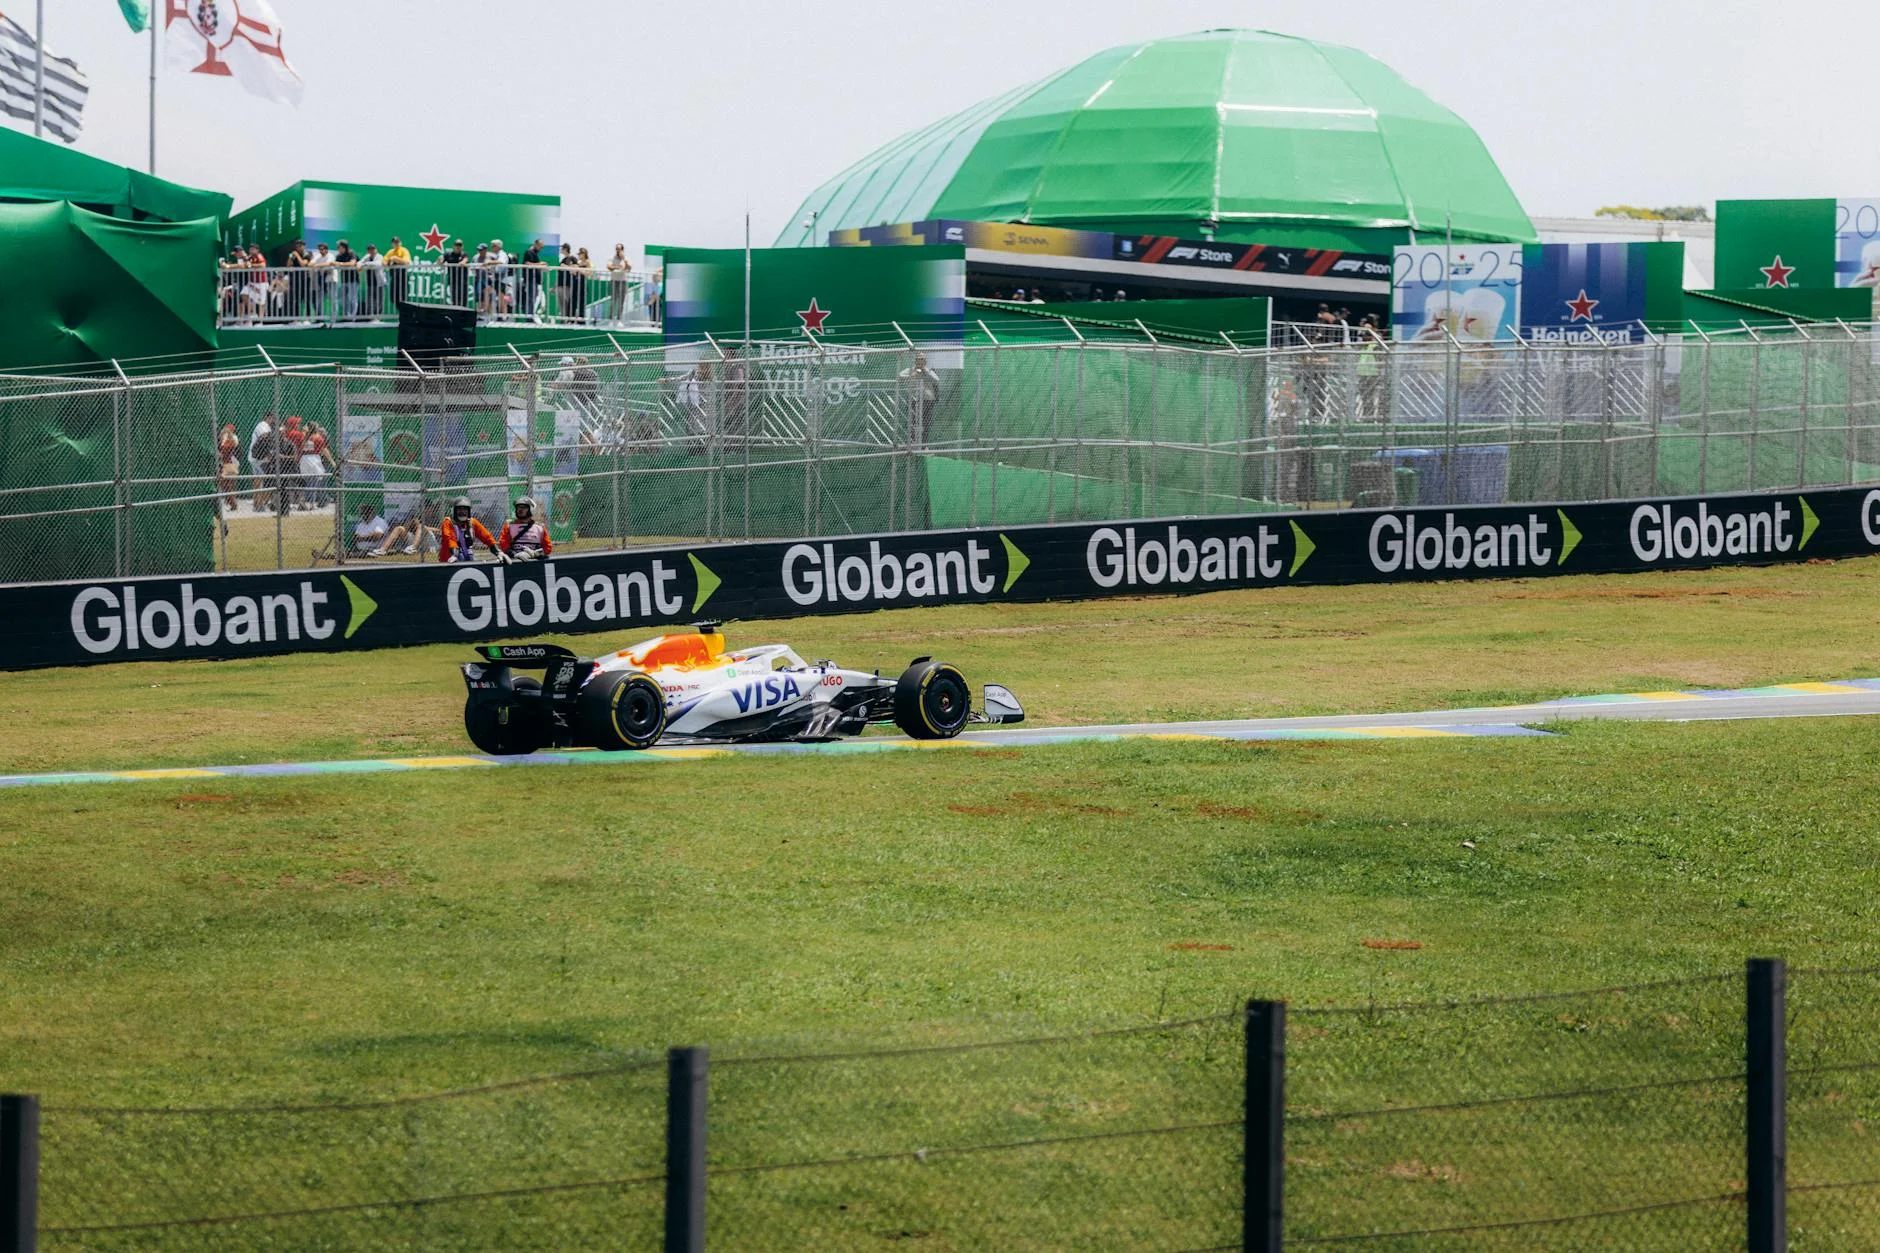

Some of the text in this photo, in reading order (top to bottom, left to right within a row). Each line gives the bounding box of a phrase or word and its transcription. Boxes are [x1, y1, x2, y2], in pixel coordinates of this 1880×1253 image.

[1200, 248, 1233, 262] Store
[1364, 261, 1392, 274] Stor
[1531, 325, 1631, 346] Heineken
[1369, 514, 1552, 572] Globant
[1629, 502, 1794, 561] Globant
[782, 540, 996, 605] Globant
[1087, 526, 1283, 587] Globant
[71, 582, 336, 653] Globant
[447, 560, 683, 631] Globant
[503, 647, 546, 657] Cash App
[662, 685, 684, 693] NDA
[730, 674, 801, 714] VISA
